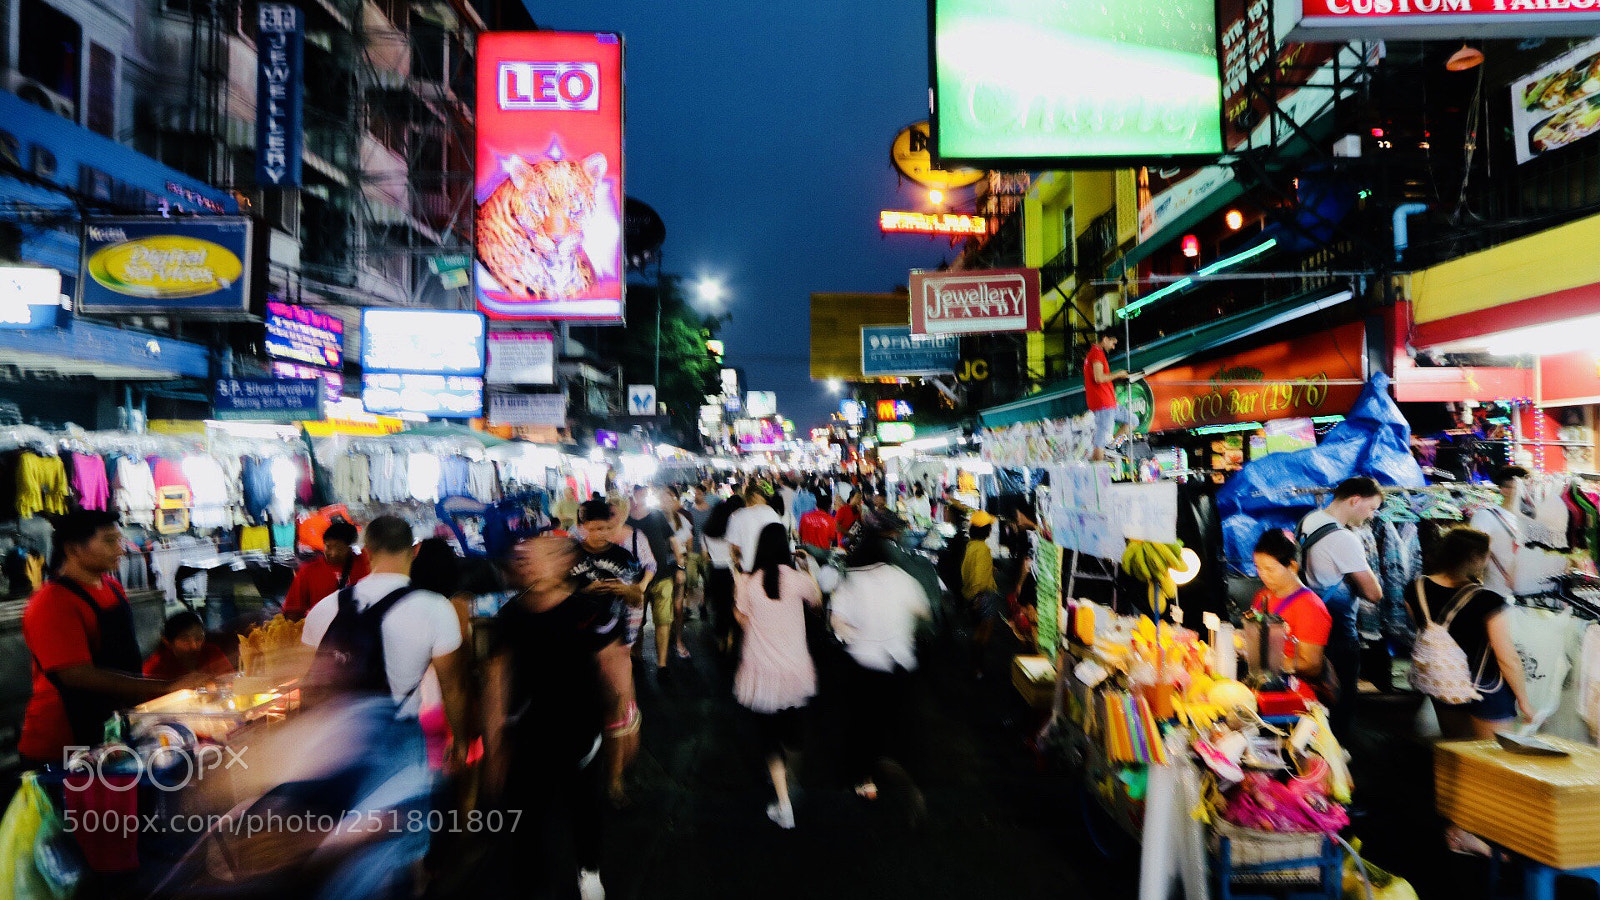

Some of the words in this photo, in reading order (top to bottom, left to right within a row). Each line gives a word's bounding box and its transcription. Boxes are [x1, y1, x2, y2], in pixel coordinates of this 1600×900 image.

[506, 69, 594, 103] LEO
[263, 34, 290, 184] JEWELLERY
[927, 282, 1025, 319] Jewellery
[958, 359, 988, 381] JC
[1227, 387, 1259, 416] Bar
[1262, 370, 1328, 417] (1976)
